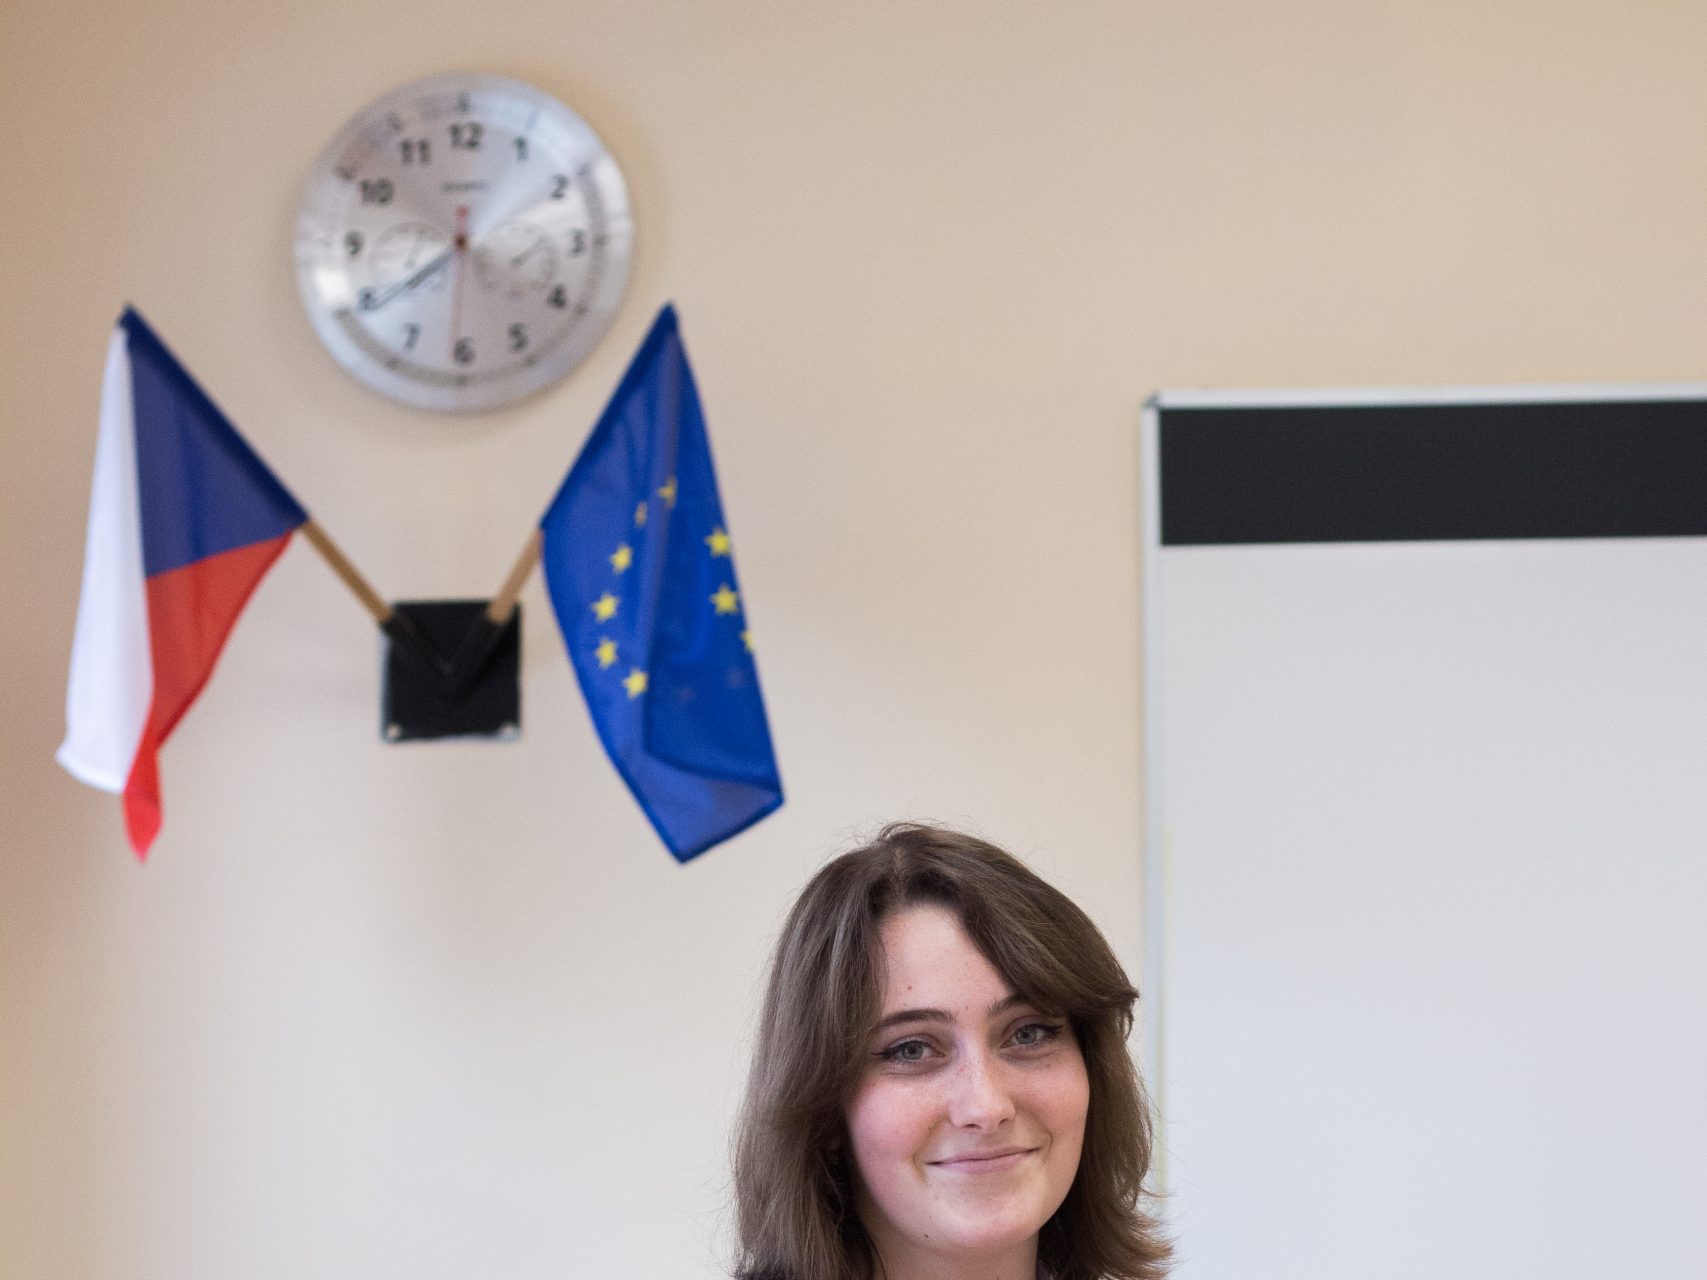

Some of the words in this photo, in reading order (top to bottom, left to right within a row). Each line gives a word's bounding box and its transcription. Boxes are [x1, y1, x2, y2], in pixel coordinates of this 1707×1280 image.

[449, 121, 484, 149] 12
[513, 136, 529, 163] 1
[398, 138, 431, 167] 11
[359, 177, 395, 207] 10
[550, 173, 569, 200] 2
[343, 231, 364, 256] 9
[569, 227, 586, 256] 3
[547, 283, 568, 311] 4
[403, 321, 421, 351] 7
[508, 322, 529, 352] 5
[452, 336, 476, 366] 6
